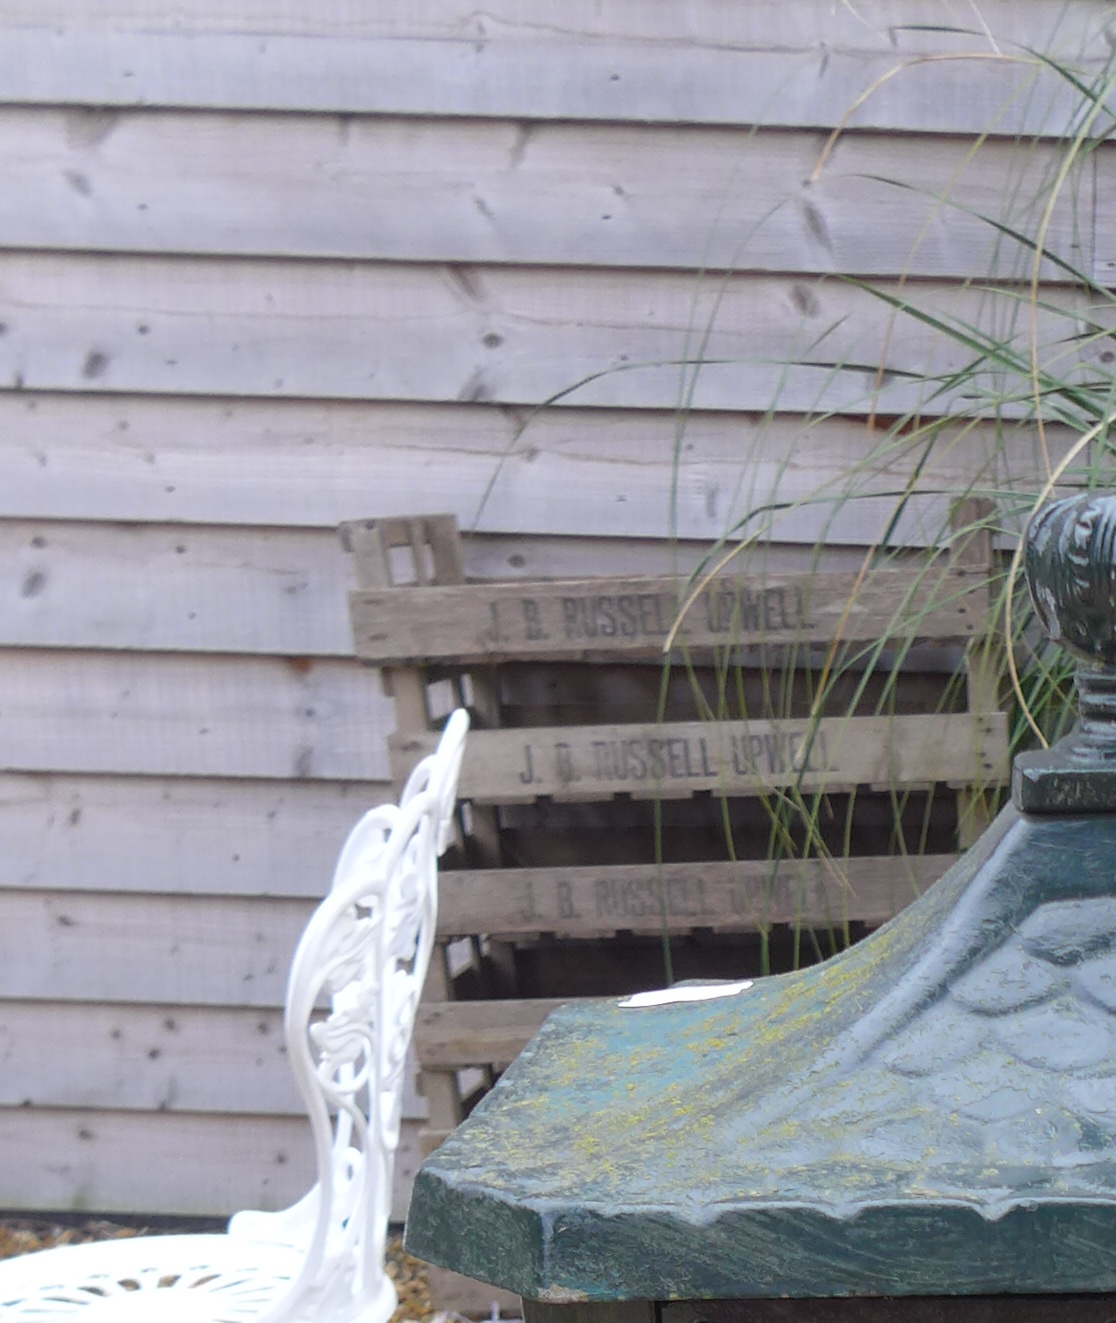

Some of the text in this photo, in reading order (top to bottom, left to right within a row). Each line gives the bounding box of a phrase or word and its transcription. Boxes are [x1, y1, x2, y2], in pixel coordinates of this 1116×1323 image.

[562, 594, 692, 639] RUSSELL
[707, 586, 816, 634] UPWELL
[520, 744, 543, 785] J.
[592, 736, 719, 780] RUSSELL
[593, 876, 718, 918] RUSSELL
